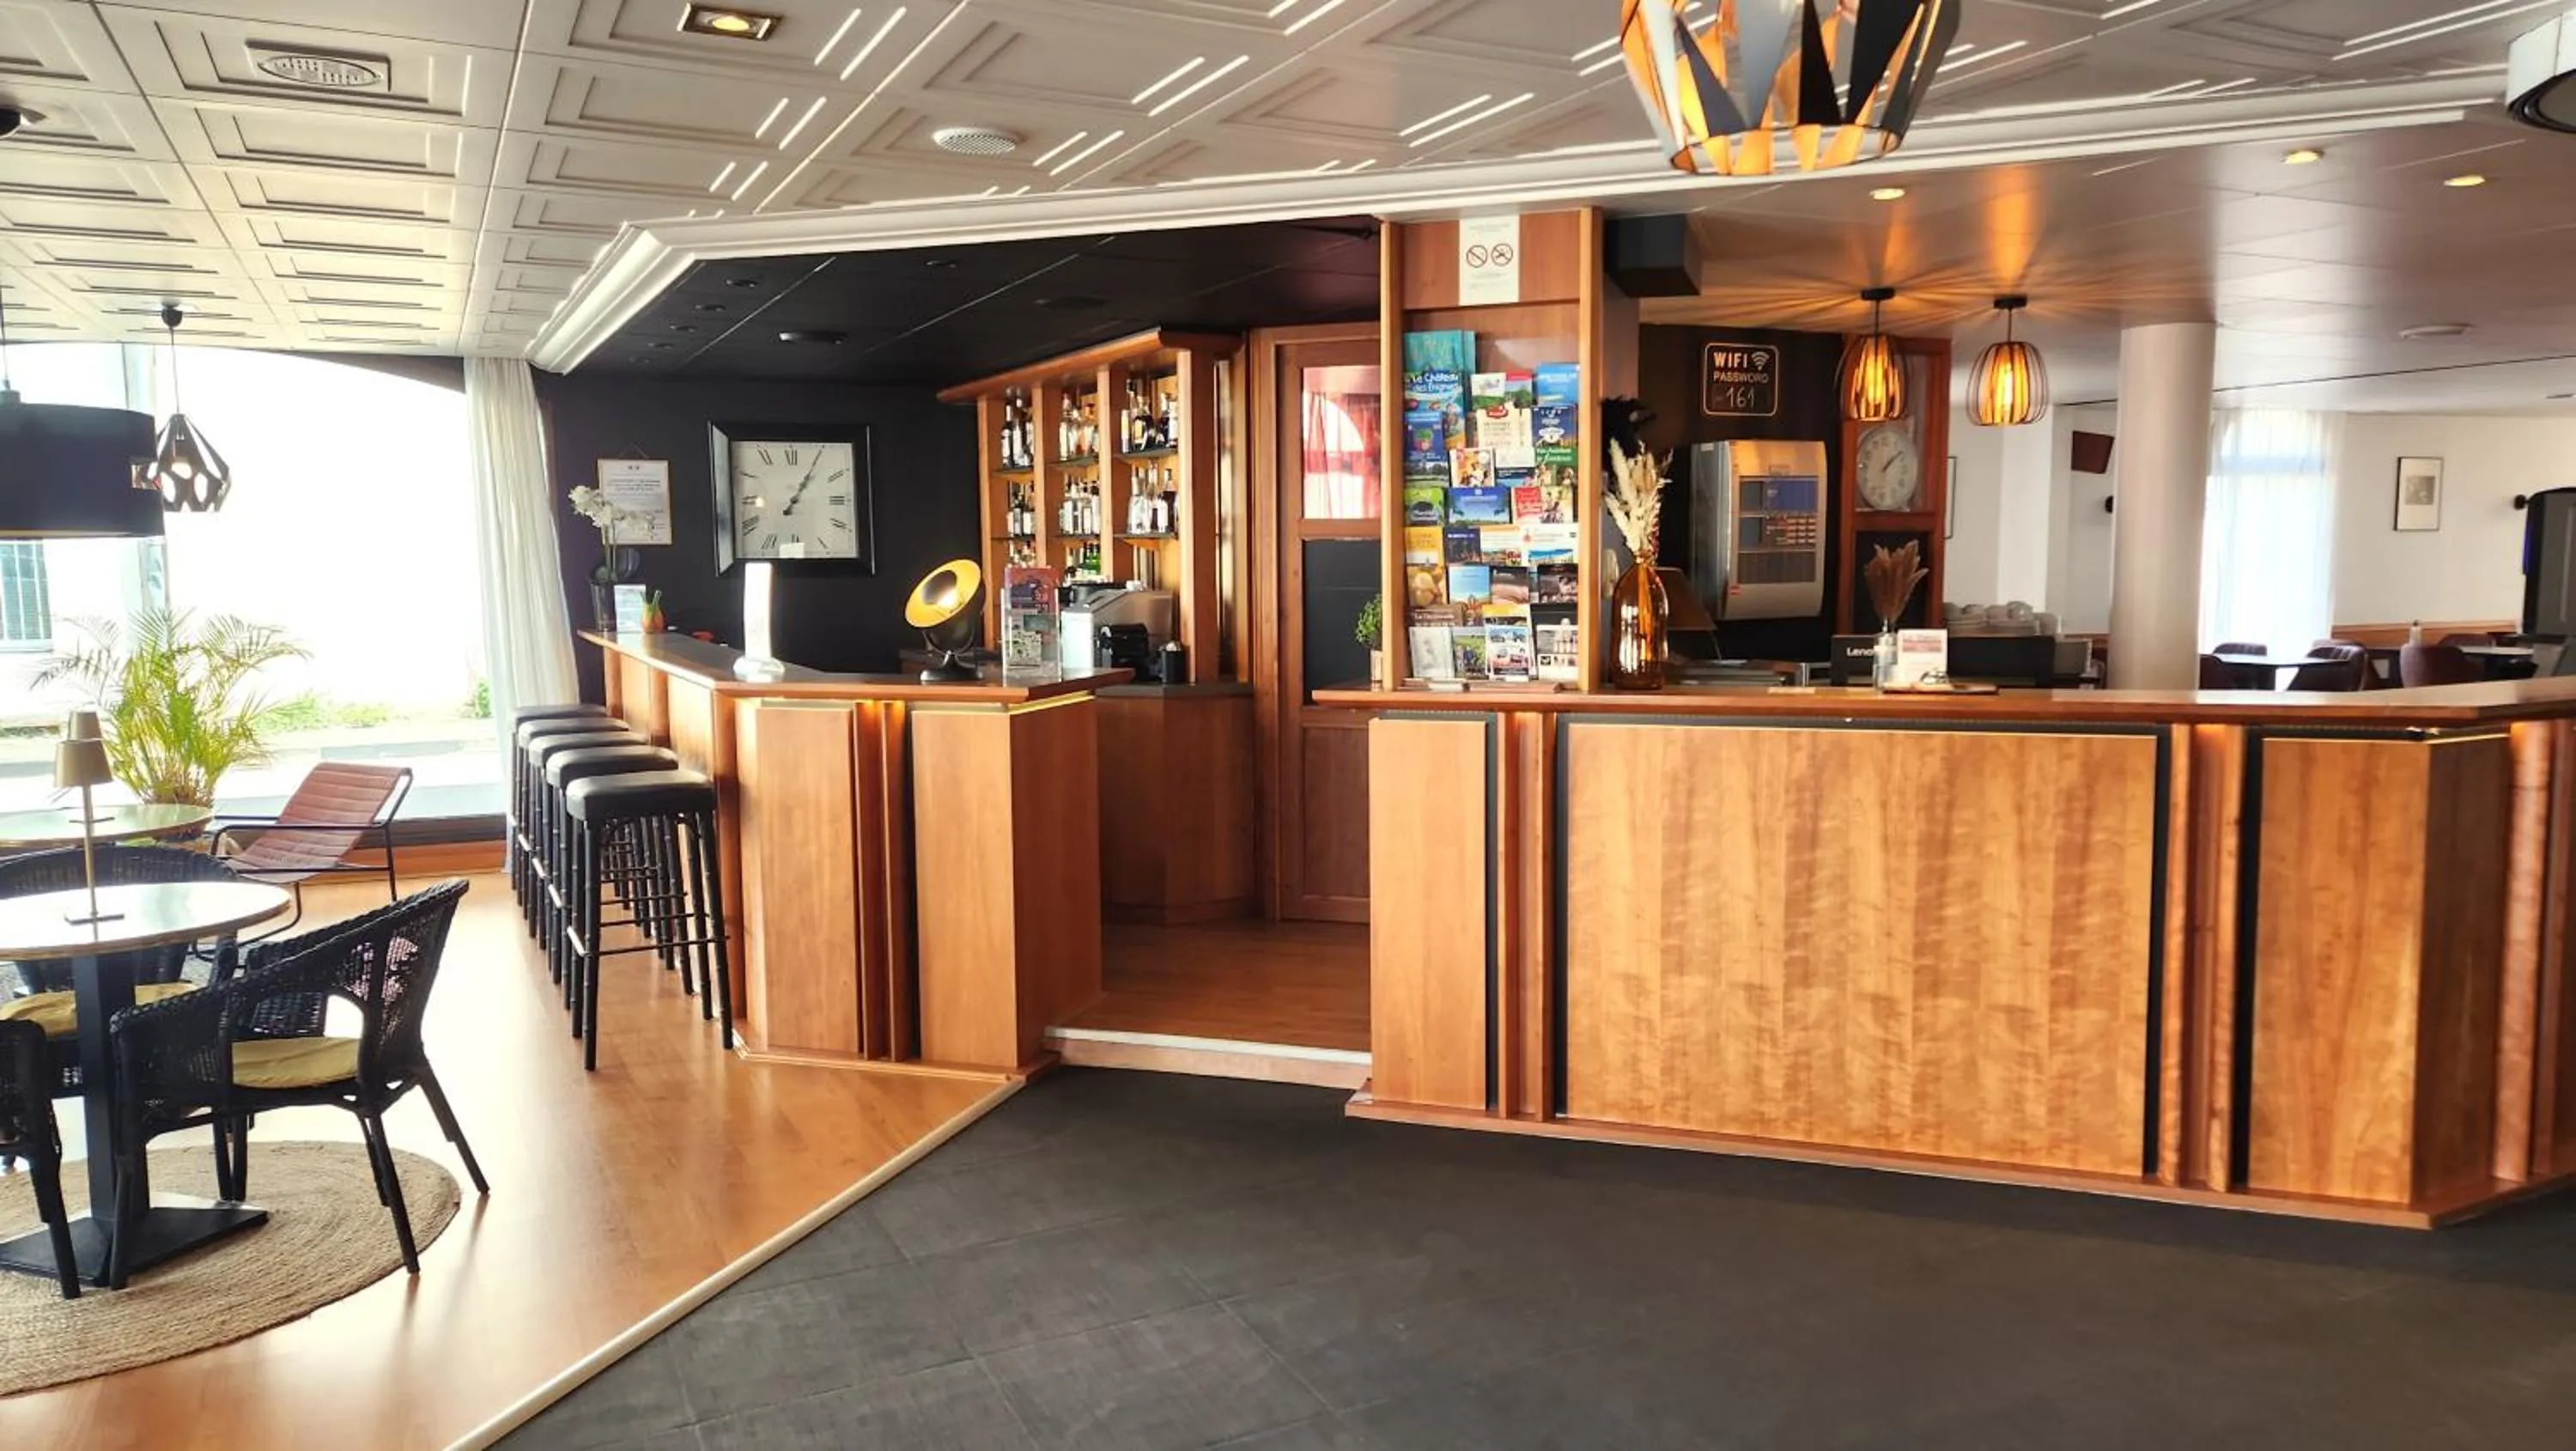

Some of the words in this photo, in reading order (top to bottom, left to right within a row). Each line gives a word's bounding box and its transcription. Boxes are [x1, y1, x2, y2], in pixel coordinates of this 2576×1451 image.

[1713, 352, 1748, 368] WIFI
[1713, 370, 1769, 384] PASSWORD
[1726, 386, 1754, 408] 161
[1846, 647, 1874, 657] Leno
